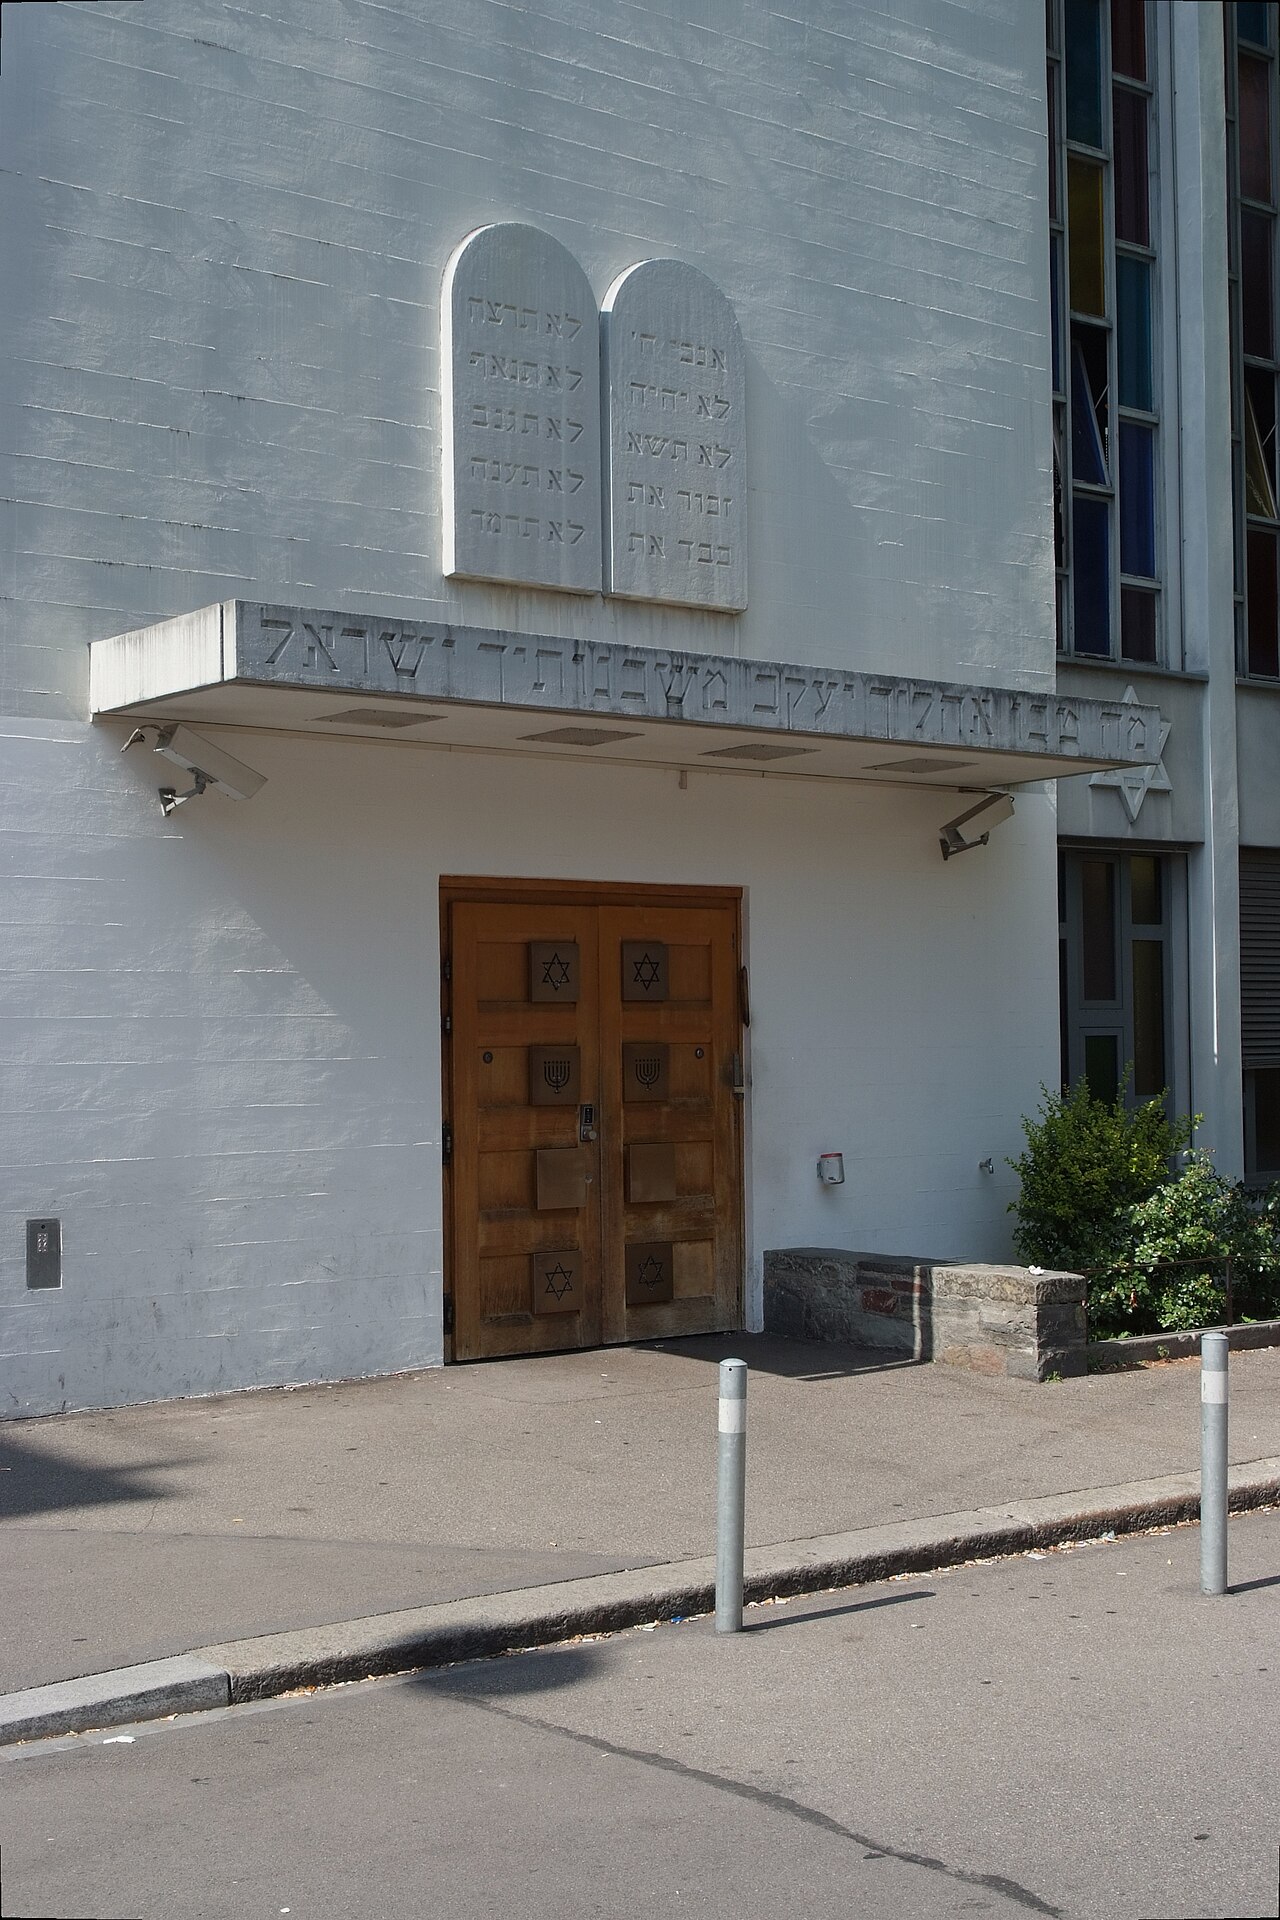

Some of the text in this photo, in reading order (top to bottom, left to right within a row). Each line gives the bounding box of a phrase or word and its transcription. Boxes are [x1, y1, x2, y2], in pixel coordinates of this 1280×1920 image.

[468, 296, 583, 341] לא תרצח
[469, 351, 584, 392] לא תנאף
[669, 340, 727, 372] אנכי
[629, 382, 732, 420] לא יהיה
[471, 404, 585, 443] לא תגנב
[626, 431, 732, 469] לא תשא
[470, 456, 585, 495] לא תענה
[627, 481, 732, 518] זכור את
[470, 509, 586, 546] לא תחמד
[628, 532, 732, 567] כבד את
[260, 605, 1146, 750] מה טבו אהליך יעקב משכנותיך ישראל
